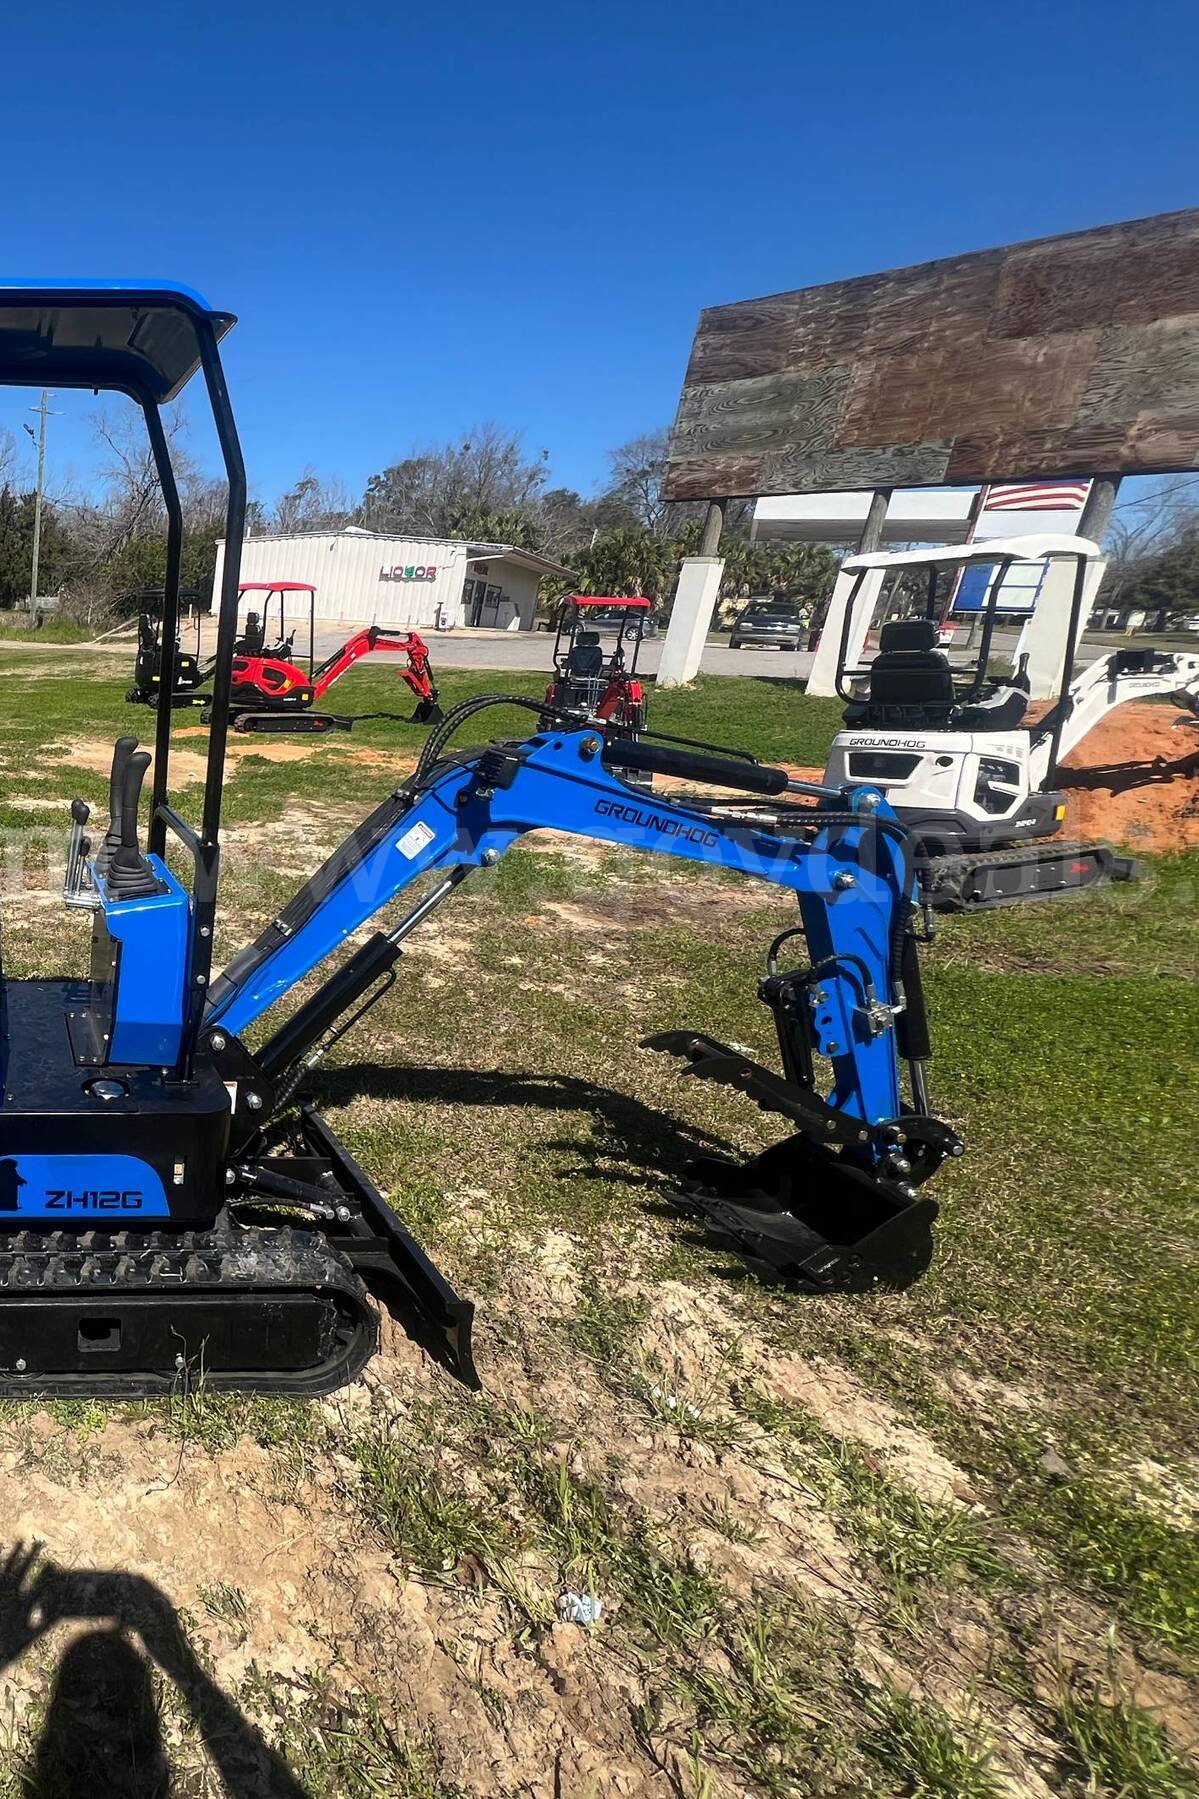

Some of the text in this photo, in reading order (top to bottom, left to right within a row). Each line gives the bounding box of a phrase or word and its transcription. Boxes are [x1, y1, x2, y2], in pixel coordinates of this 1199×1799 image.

[380, 565, 437, 579] LIQUOR
[849, 738, 926, 748] GROUNDHOG
[594, 799, 719, 848] GROUNDHOG
[45, 1190, 142, 1209] ZH12G
